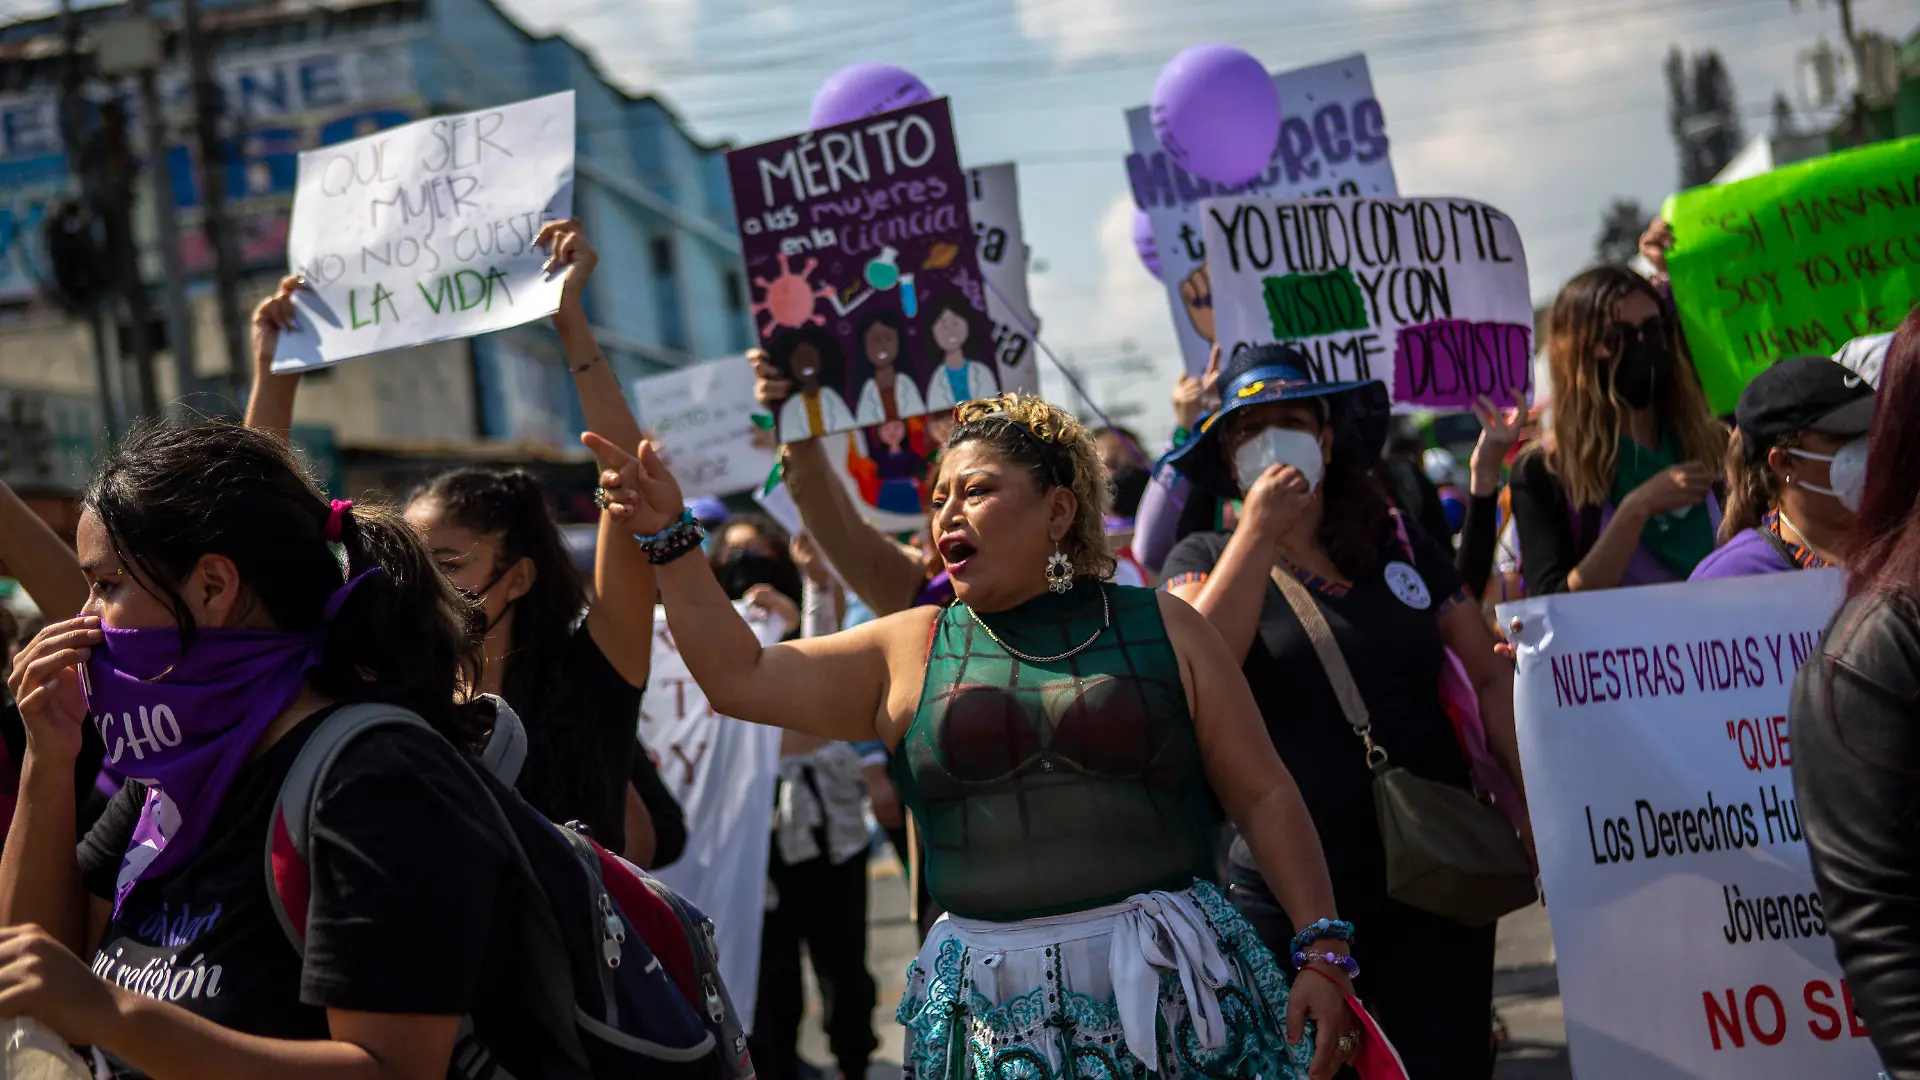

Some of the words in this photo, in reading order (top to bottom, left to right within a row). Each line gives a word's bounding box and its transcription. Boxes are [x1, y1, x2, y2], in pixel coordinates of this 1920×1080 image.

[322, 139, 396, 198] QUE
[422, 111, 514, 173] SER
[757, 114, 936, 207] MÉRITO
[370, 175, 479, 238] MUJER
[742, 216, 763, 236] a
[762, 204, 800, 232] las
[809, 175, 949, 224] mujeres
[1211, 204, 1274, 273] YO
[1352, 200, 1447, 268] COMO
[1448, 202, 1514, 263] ME
[298, 252, 346, 286] NO
[360, 233, 441, 275] NOS
[453, 208, 557, 264] CUESTE
[779, 235, 813, 256] en
[809, 226, 839, 249] la
[349, 281, 400, 331] LA
[416, 265, 514, 315] VIDA
[1266, 273, 1359, 337] VISTO
[1357, 269, 1385, 329] Y
[1387, 266, 1453, 326] CON
[1715, 269, 1784, 318] SOY
[1403, 322, 1530, 401] DESVISTO
[1551, 643, 1685, 708] NUESTRAS
[1686, 635, 1766, 694] VIDAS
[1768, 633, 1783, 685] Y
[93, 703, 182, 764] CHO
[1585, 805, 1634, 865] Los
[1634, 791, 1756, 859] Derechos
[115, 952, 223, 1001] religión
[1702, 984, 1787, 1051] NO
